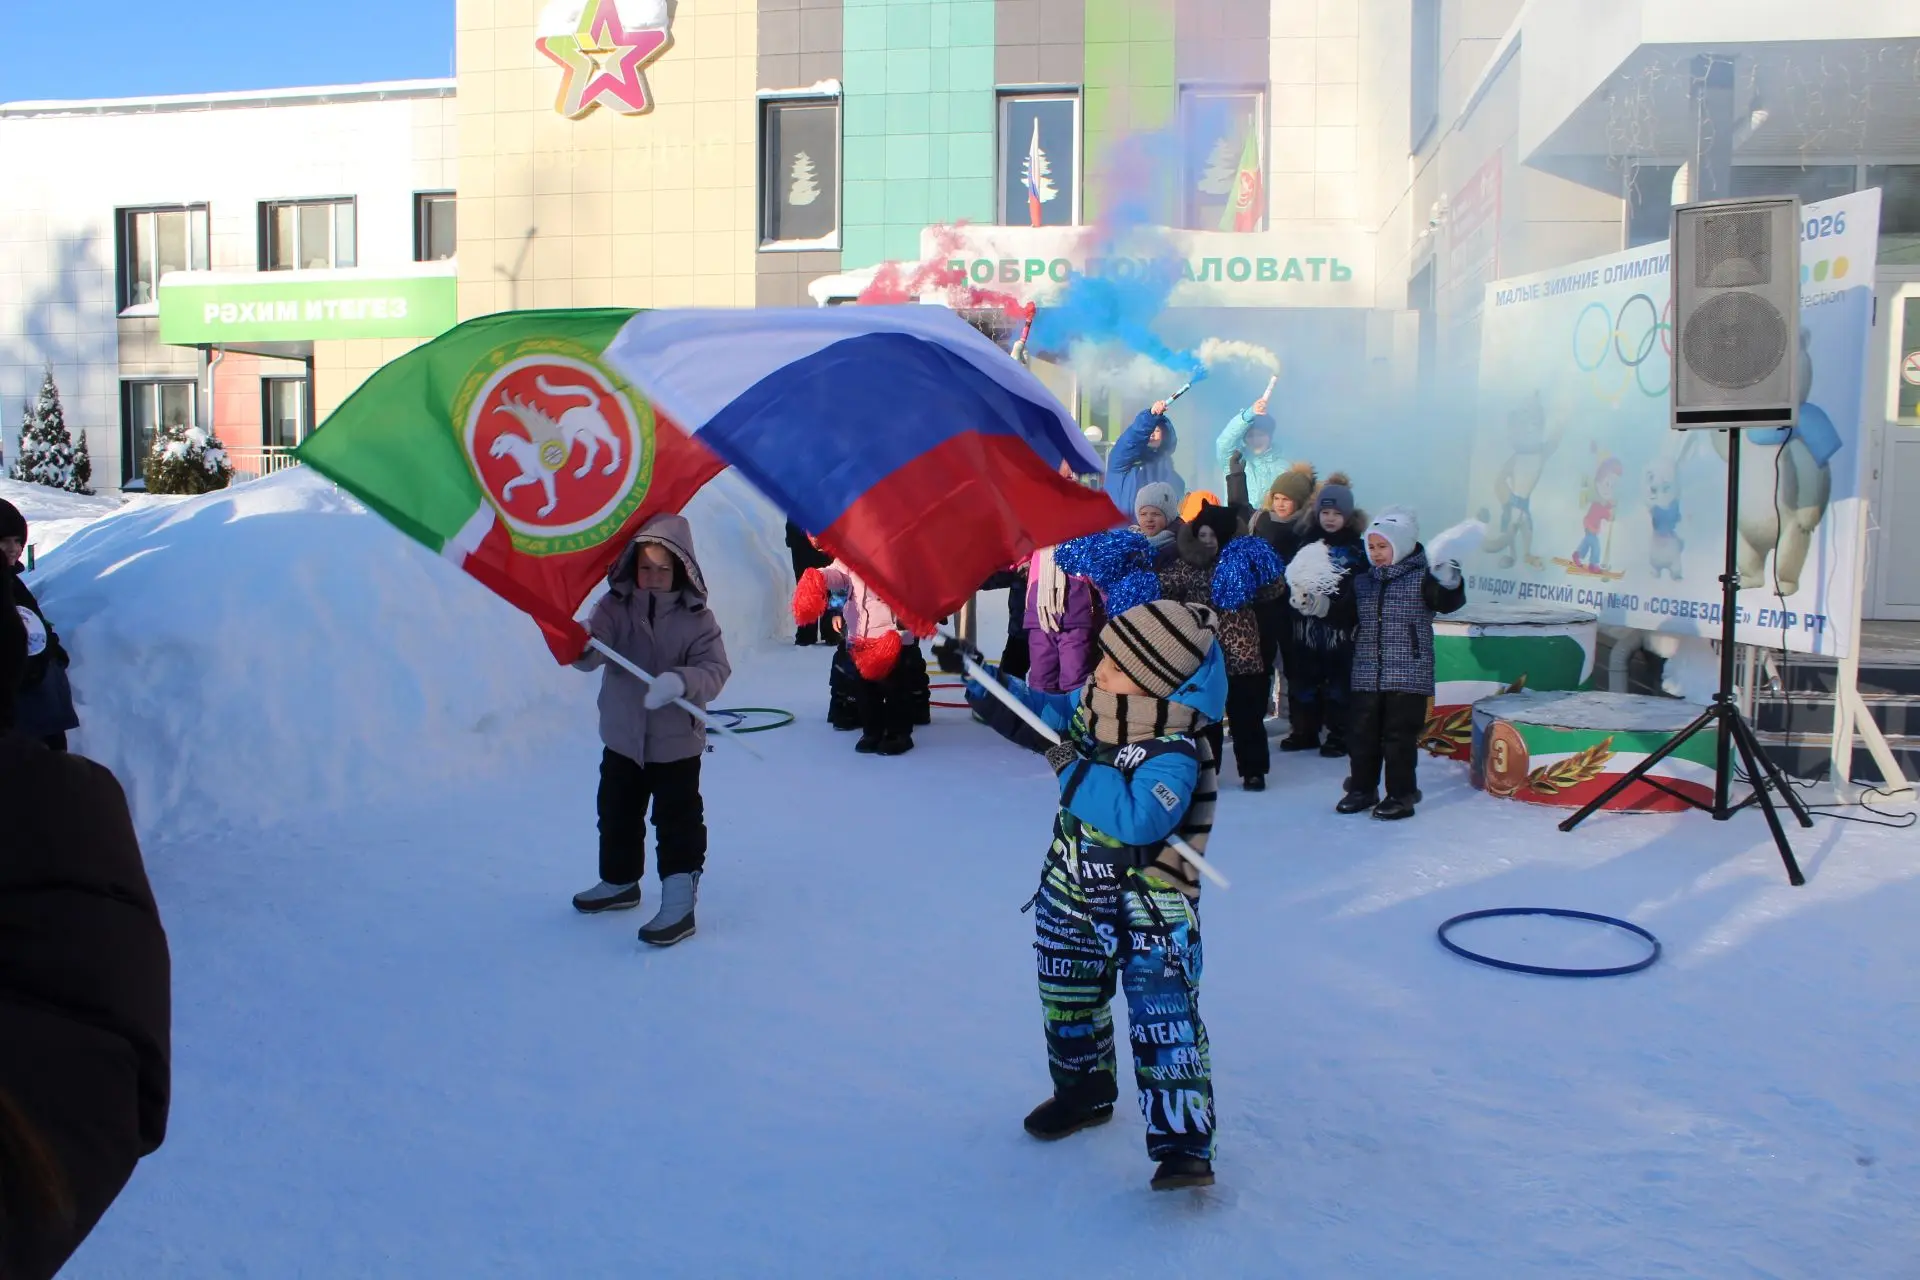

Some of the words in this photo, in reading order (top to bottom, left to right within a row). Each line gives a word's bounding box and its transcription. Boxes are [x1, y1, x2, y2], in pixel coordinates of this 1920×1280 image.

[1495, 284, 1540, 306] МАЛЫЕ
[1543, 270, 1600, 297] ЗИМНИЕ
[203, 301, 298, 324] РӘХИМ
[305, 297, 409, 320] ИТЕГЕЗ
[1468, 575, 1477, 589] В
[1478, 576, 1516, 596] МБДОУ
[1518, 582, 1573, 604] ДЕТСКИЙ
[1577, 589, 1603, 610] САД
[1607, 592, 1639, 612] №40
[1643, 597, 1751, 625] «СОЗВЕЗДЕ»
[1757, 608, 1798, 630] ЕМР
[1804, 613, 1828, 634] РТ
[1493, 739, 1508, 773] 3
